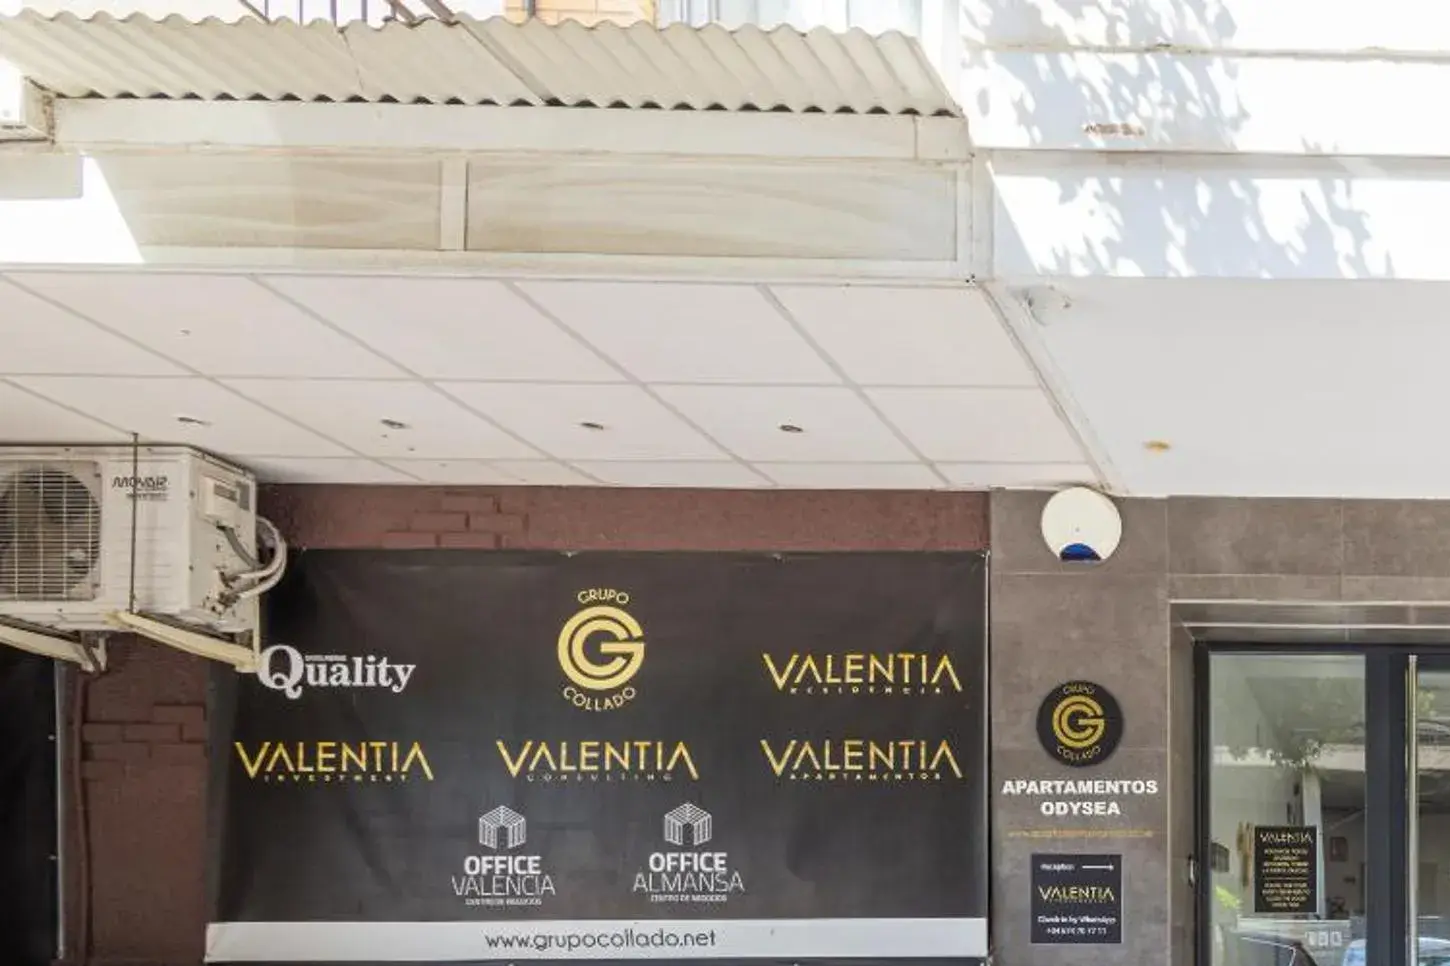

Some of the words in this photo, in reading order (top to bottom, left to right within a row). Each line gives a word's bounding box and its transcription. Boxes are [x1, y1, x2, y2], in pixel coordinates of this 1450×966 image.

[577, 588, 629, 604] GRUPO
[257, 644, 416, 699] Quality
[762, 652, 963, 692] VALENTIA
[563, 686, 636, 712] COLLADO
[234, 741, 434, 781] VALENTIA
[496, 740, 699, 780] VALENTIA
[760, 739, 963, 779] VALENTIA
[264, 774, 407, 783] INVESTMENT
[790, 772, 941, 781] APARTAMENTOS
[1002, 780, 1159, 796] APARTAMENTOS
[1040, 801, 1121, 816] ODYSEA
[464, 855, 542, 875] OFFICE
[649, 852, 728, 872] OFFICE
[450, 875, 556, 896] VALENCIA
[632, 871, 745, 892] ALMANSA
[1038, 885, 1115, 902] VALENTIA
[485, 928, 717, 951] www.grupocollado.net
